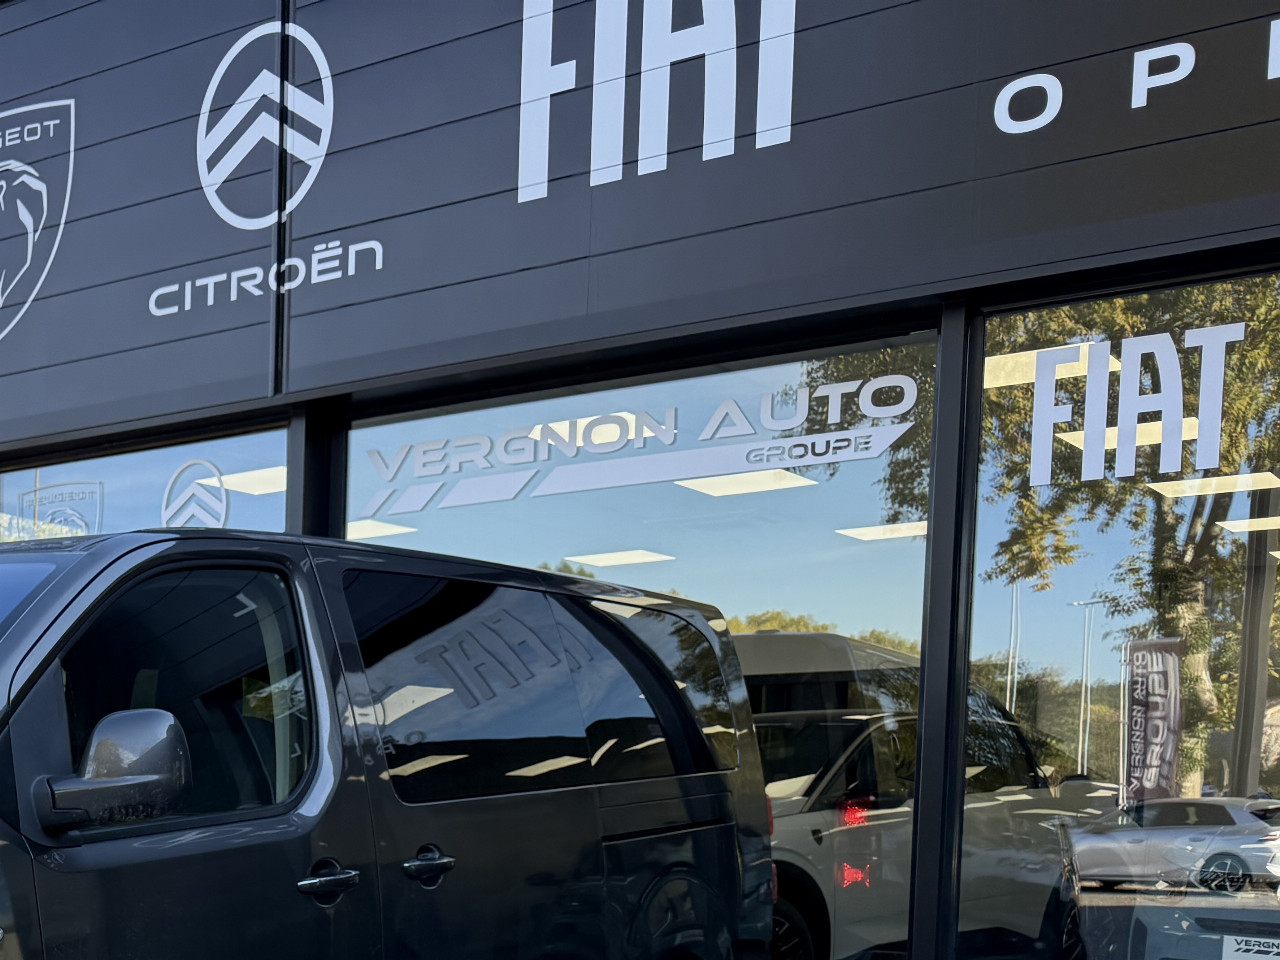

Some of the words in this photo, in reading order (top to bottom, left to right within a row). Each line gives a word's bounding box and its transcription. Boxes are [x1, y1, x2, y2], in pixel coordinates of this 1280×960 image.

[993, 18, 1280, 134] OP
[365, 405, 678, 482] VERGNON
[697, 373, 919, 442] AUTO
[745, 433, 874, 465] GROUPE
[1030, 322, 1246, 487] FIAT
